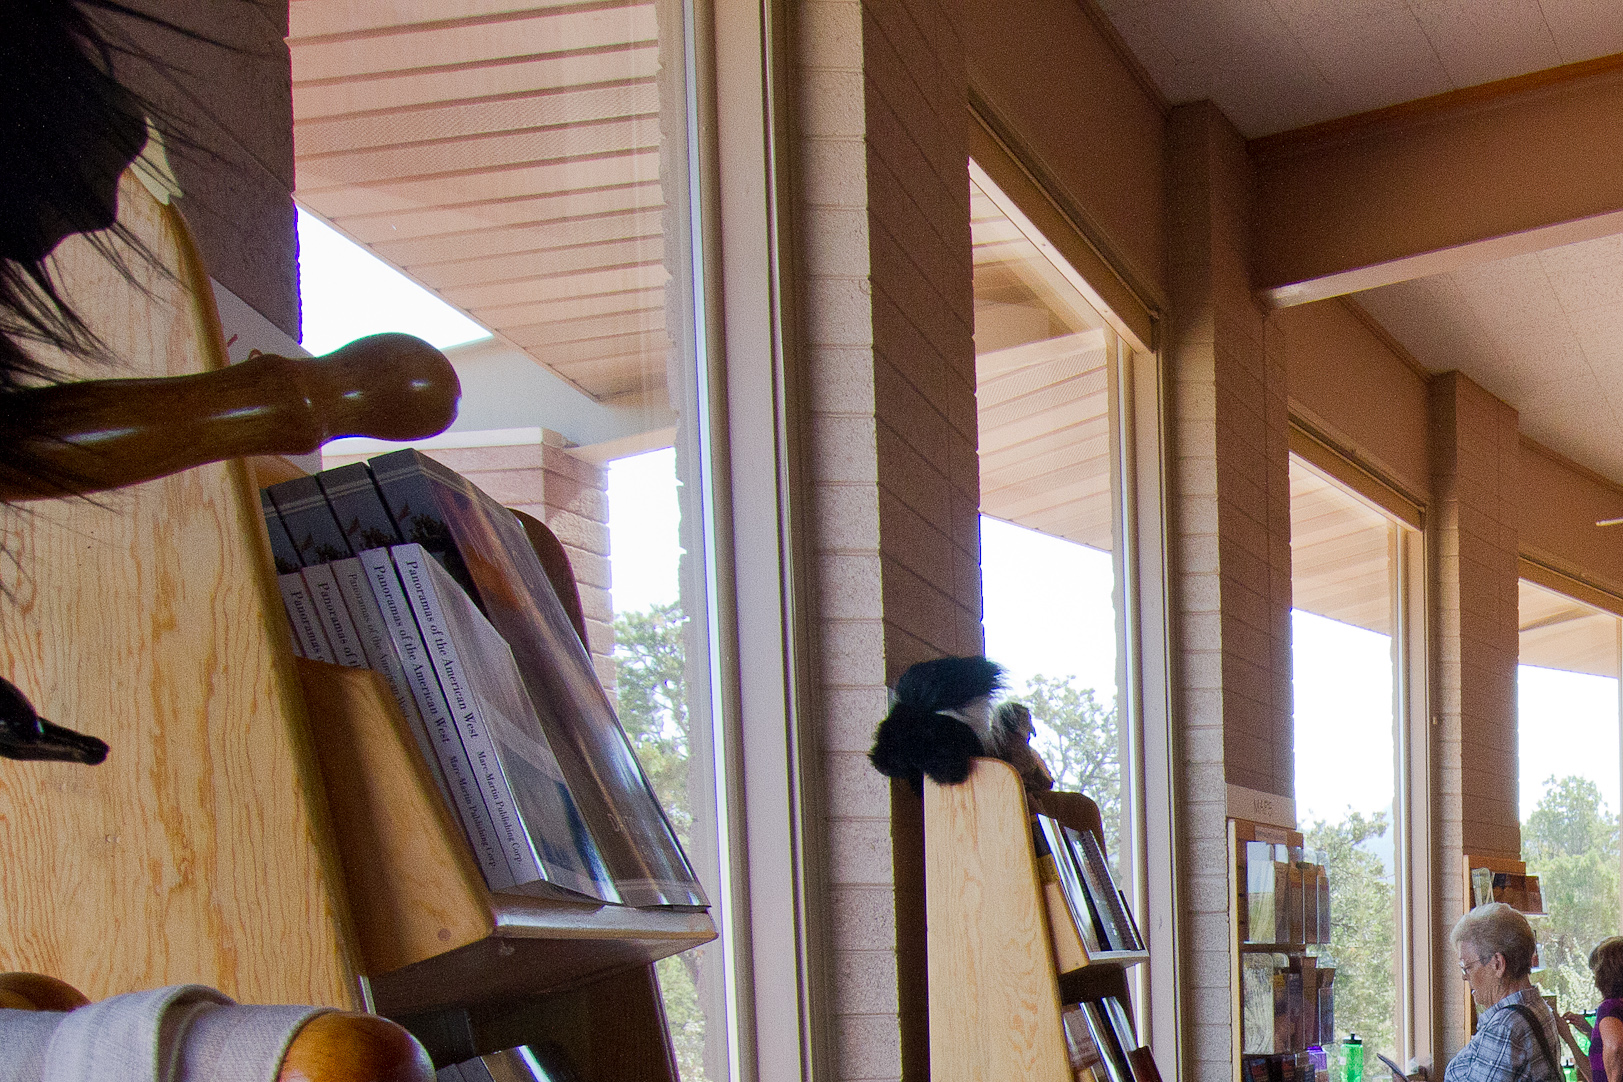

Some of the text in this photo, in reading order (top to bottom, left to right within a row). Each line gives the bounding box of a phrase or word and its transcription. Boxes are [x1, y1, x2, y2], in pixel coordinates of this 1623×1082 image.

[318, 582, 348, 644] Panoramas
[349, 573, 370, 623] Panoramas
[373, 563, 404, 628] Panoramas
[405, 560, 435, 622] Panoramas
[291, 591, 322, 653] Panoramas
[399, 629, 412, 645] of
[429, 622, 442, 638] of
[435, 632, 447, 657] the
[405, 638, 418, 664] the
[412, 661, 438, 718] American
[442, 653, 467, 711] American
[435, 714, 451, 744] West
[463, 709, 478, 739] West
